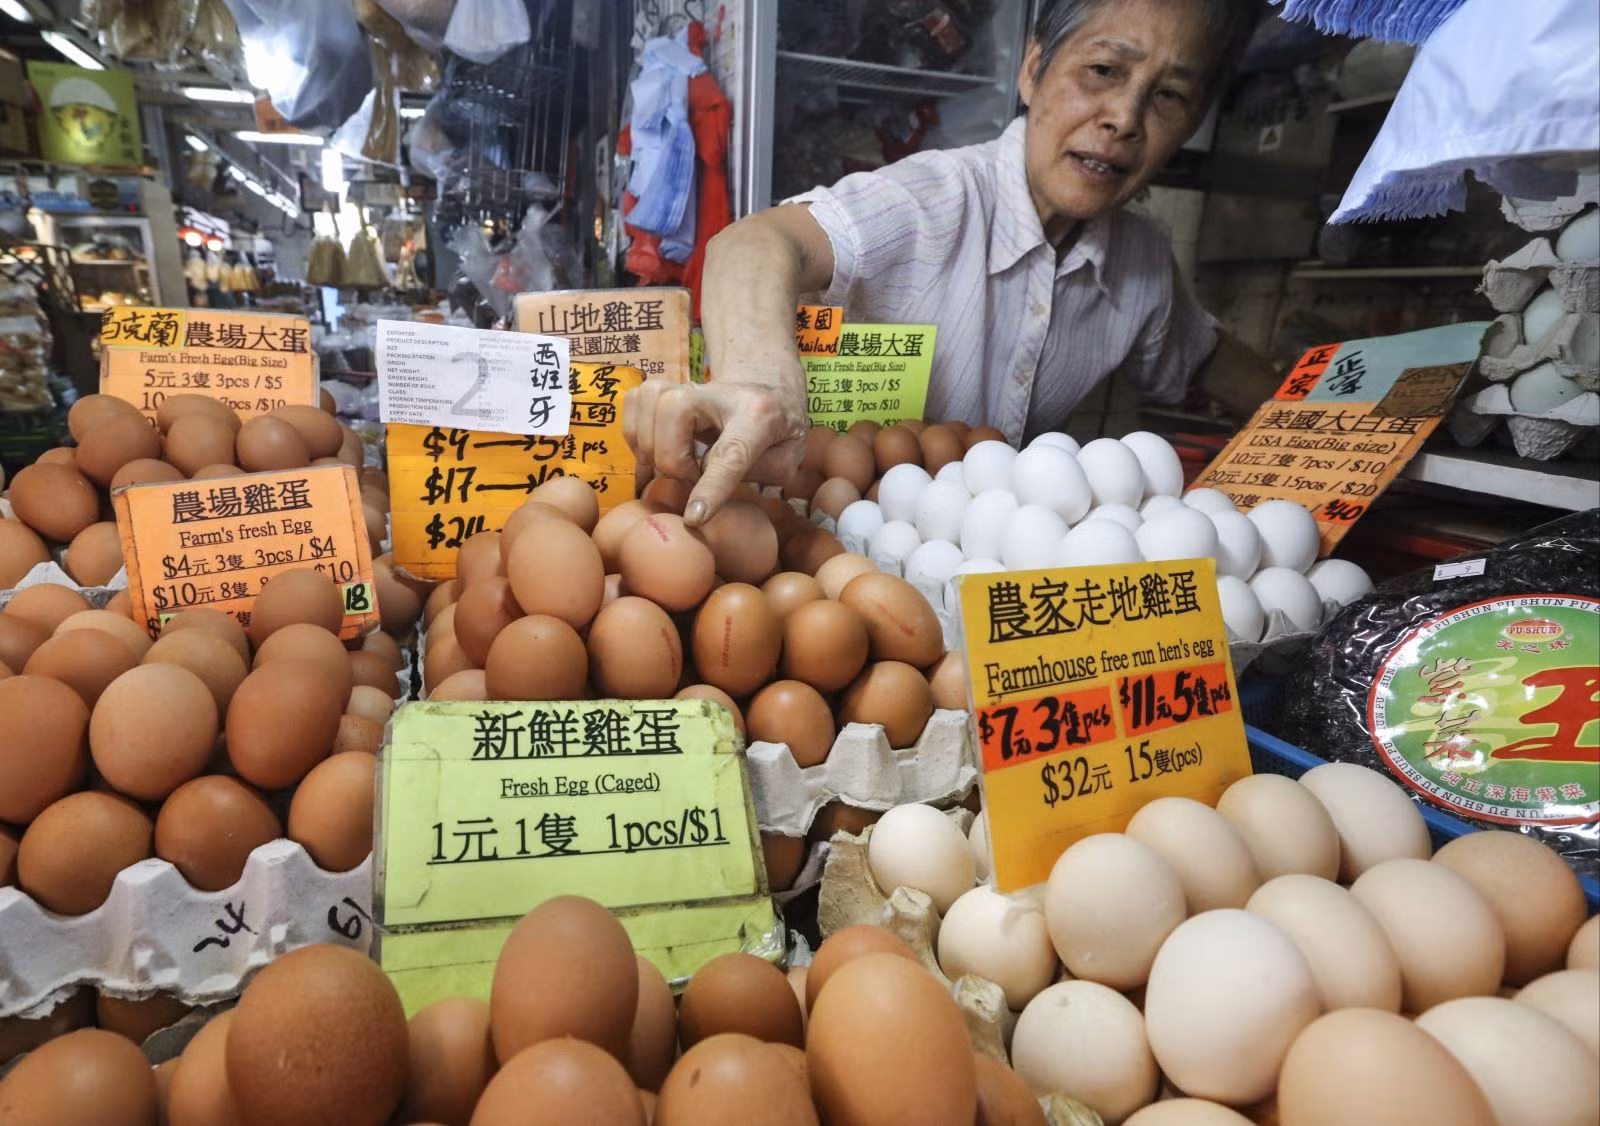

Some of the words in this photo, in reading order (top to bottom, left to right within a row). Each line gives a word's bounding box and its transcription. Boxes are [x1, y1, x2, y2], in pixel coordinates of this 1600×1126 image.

[538, 300, 664, 336] 山地雞蛋
[185, 321, 308, 353] 農場大蛋
[839, 332, 925, 357] 農場大蛋
[140, 352, 176, 363] Farm's
[180, 353, 209, 365] Fresh
[261, 356, 288, 368] Size)
[807, 361, 831, 372] Farm's
[834, 361, 854, 372] Fresh
[887, 362, 906, 372] Size)
[144, 368, 176, 388] 5元
[216, 374, 250, 389] 3pcs
[265, 377, 283, 390] $5
[856, 379, 879, 393] 3pcs
[888, 379, 901, 391] $5
[588, 404, 616, 424] Egg
[857, 400, 877, 412] 7pcs
[582, 440, 608, 463] pcs
[1250, 435, 1280, 448] USA
[1288, 437, 1353, 452] Egg(Big
[1353, 439, 1397, 455] size)
[1299, 455, 1336, 470] 7pcs
[1349, 460, 1387, 475] $10
[420, 466, 477, 506] $17
[1281, 476, 1327, 492] 15pcs
[1341, 481, 1378, 497] $20
[172, 478, 313, 524] 農場雞蛋
[179, 527, 234, 548] Farm's
[239, 520, 277, 543] fresh
[282, 518, 313, 536] Egg
[254, 546, 294, 567] 3pcs
[310, 535, 337, 560] $4
[345, 583, 369, 611] 18
[987, 569, 1202, 643] 農家走地雞蛋
[1453, 604, 1492, 622] SHUN
[1520, 599, 1565, 607] SHUN
[1569, 601, 1591, 610] PU
[1509, 626, 1523, 635] PU
[1525, 626, 1558, 635] SHUN
[984, 651, 1098, 697] Farmhouse
[1100, 649, 1129, 673] free
[1132, 650, 1156, 668] run
[1157, 638, 1190, 662] hen's
[1193, 638, 1215, 659] egg
[471, 708, 683, 760] 新鮮雞蛋
[500, 776, 549, 798] Fresh
[554, 774, 590, 798] Egg
[594, 772, 662, 795] (Caged)
[430, 815, 499, 864] 1元
[515, 812, 580, 857] 1隻
[606, 805, 729, 855] 1pcs/$1
